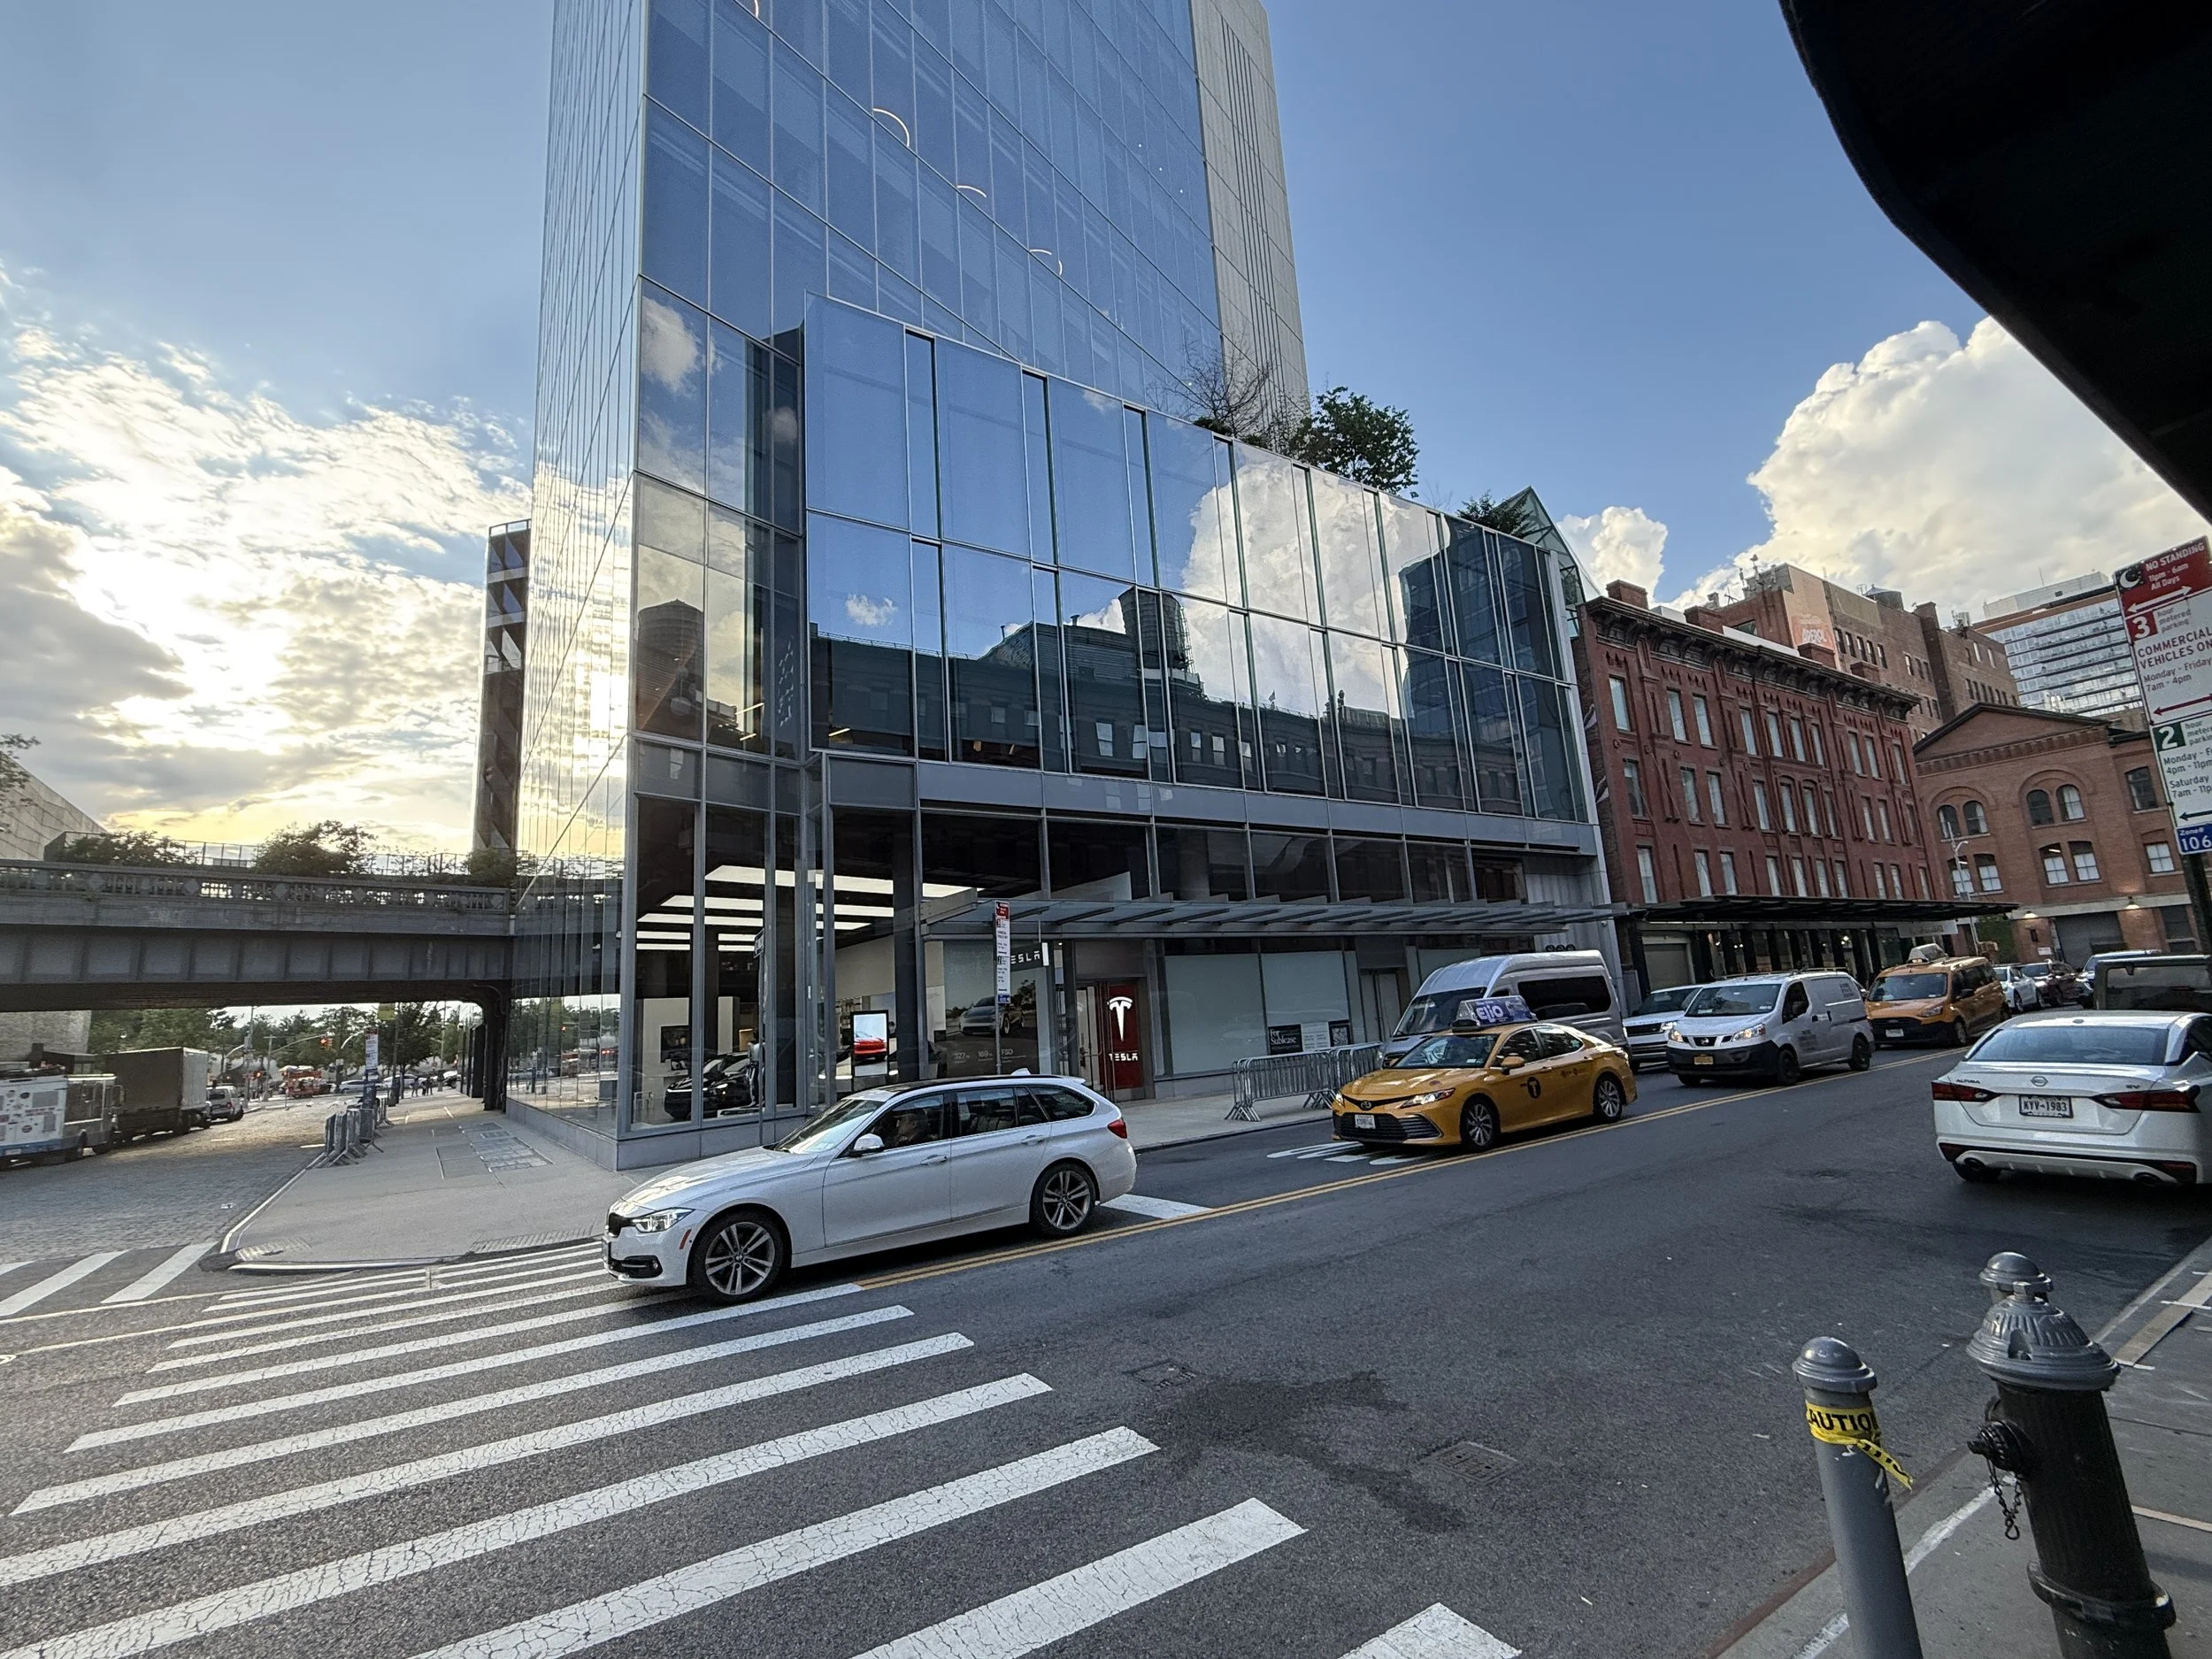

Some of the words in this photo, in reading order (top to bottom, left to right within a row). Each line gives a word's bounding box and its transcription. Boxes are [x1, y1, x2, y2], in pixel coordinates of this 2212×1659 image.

[2146, 560, 2159, 572] NO
[2160, 541, 2205, 566] STANDING
[2172, 563, 2189, 573] 6am
[2162, 576, 2180, 587] Days
[2159, 609, 2192, 625] metered
[2131, 616, 2151, 640] 3
[2138, 626, 2212, 657] COMMERCIAL
[2140, 645, 2194, 669] VEHICLES
[2196, 639, 2212, 652] ON
[2144, 669, 2176, 682] Monday
[2184, 657, 2212, 671] Friday
[2147, 682, 2164, 691] 7am
[2172, 674, 2192, 684] 4pm
[2159, 726, 2178, 749] 2
[2163, 752, 2197, 764] Monday
[2166, 765, 2185, 775] 4pm
[2170, 775, 2209, 788] Saturday
[2172, 788, 2192, 798] 7am
[1010, 950, 1041, 964] ESLA
[1271, 1029, 1280, 1038] For
[1109, 1053, 1138, 1062] TESLA
